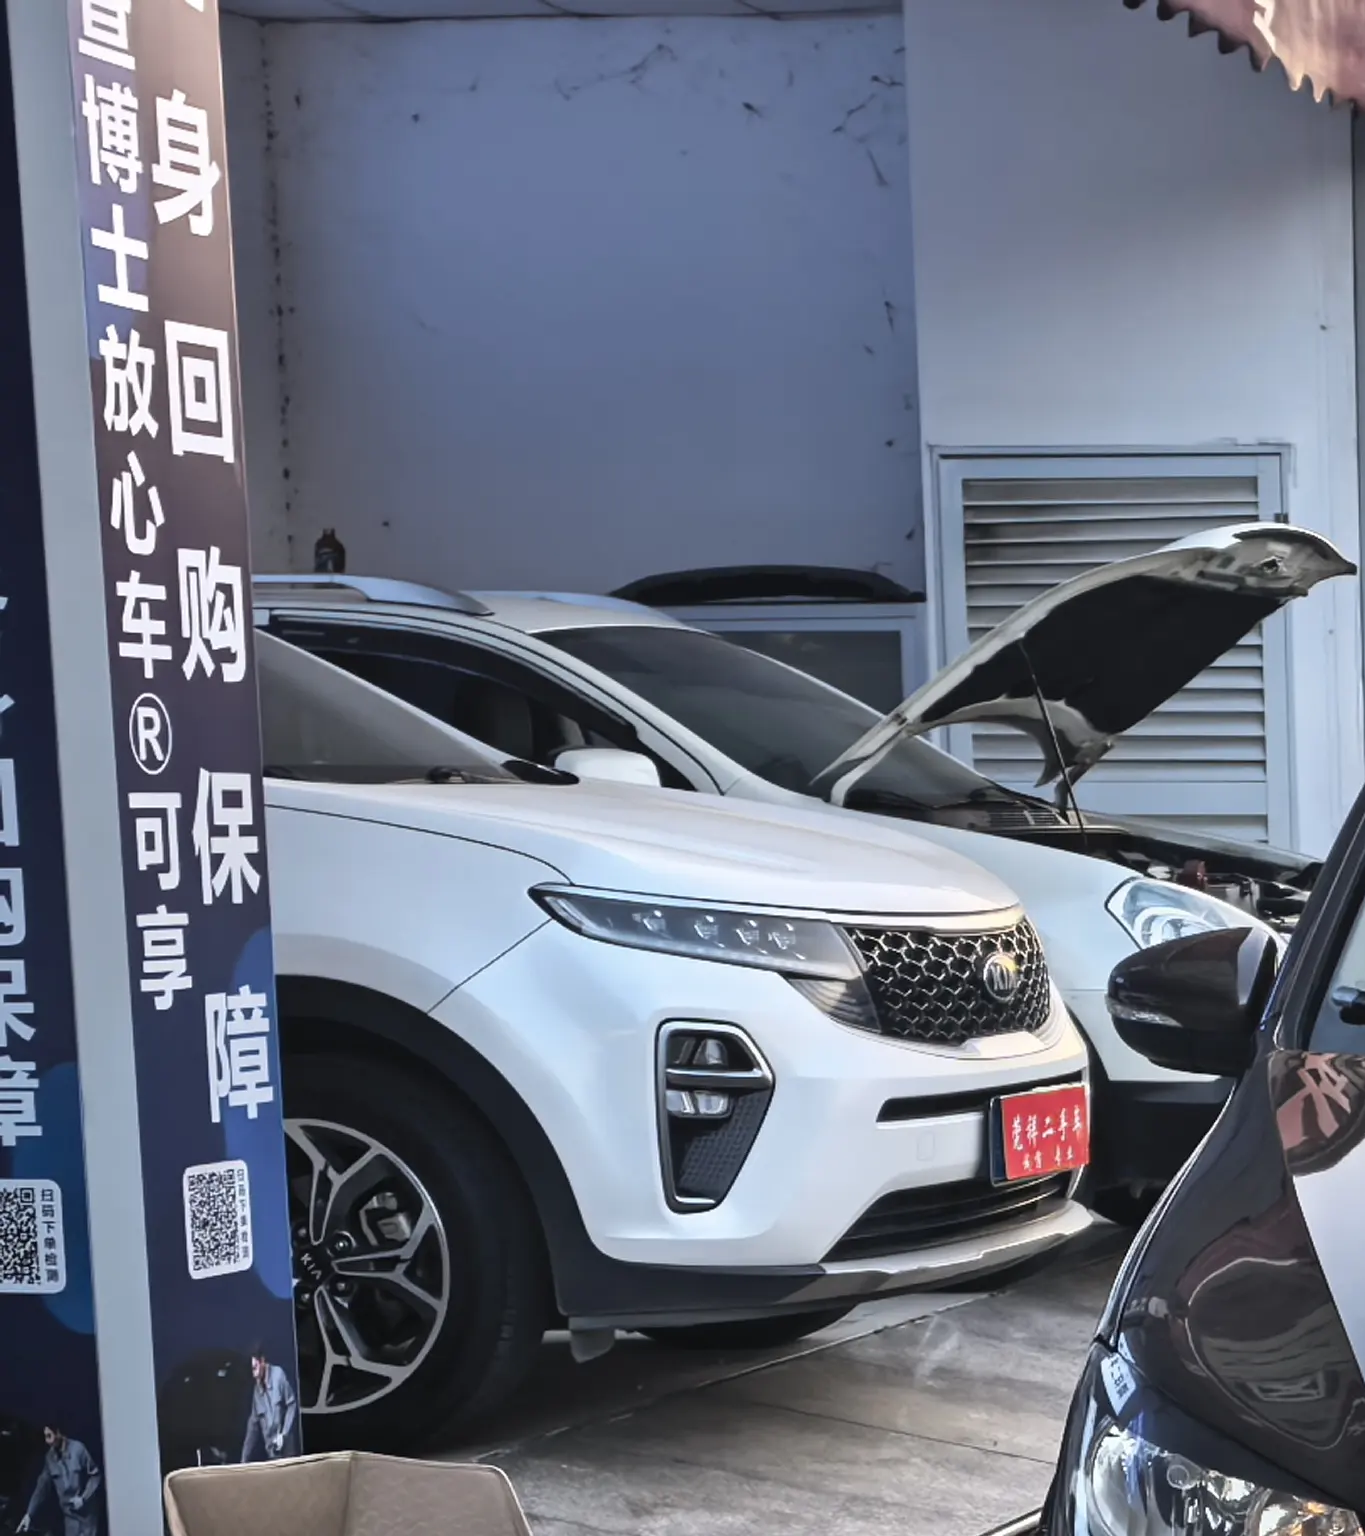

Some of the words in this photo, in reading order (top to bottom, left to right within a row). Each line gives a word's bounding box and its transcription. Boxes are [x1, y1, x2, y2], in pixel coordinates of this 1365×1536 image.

[151, 0, 274, 1124] 身回购保障
